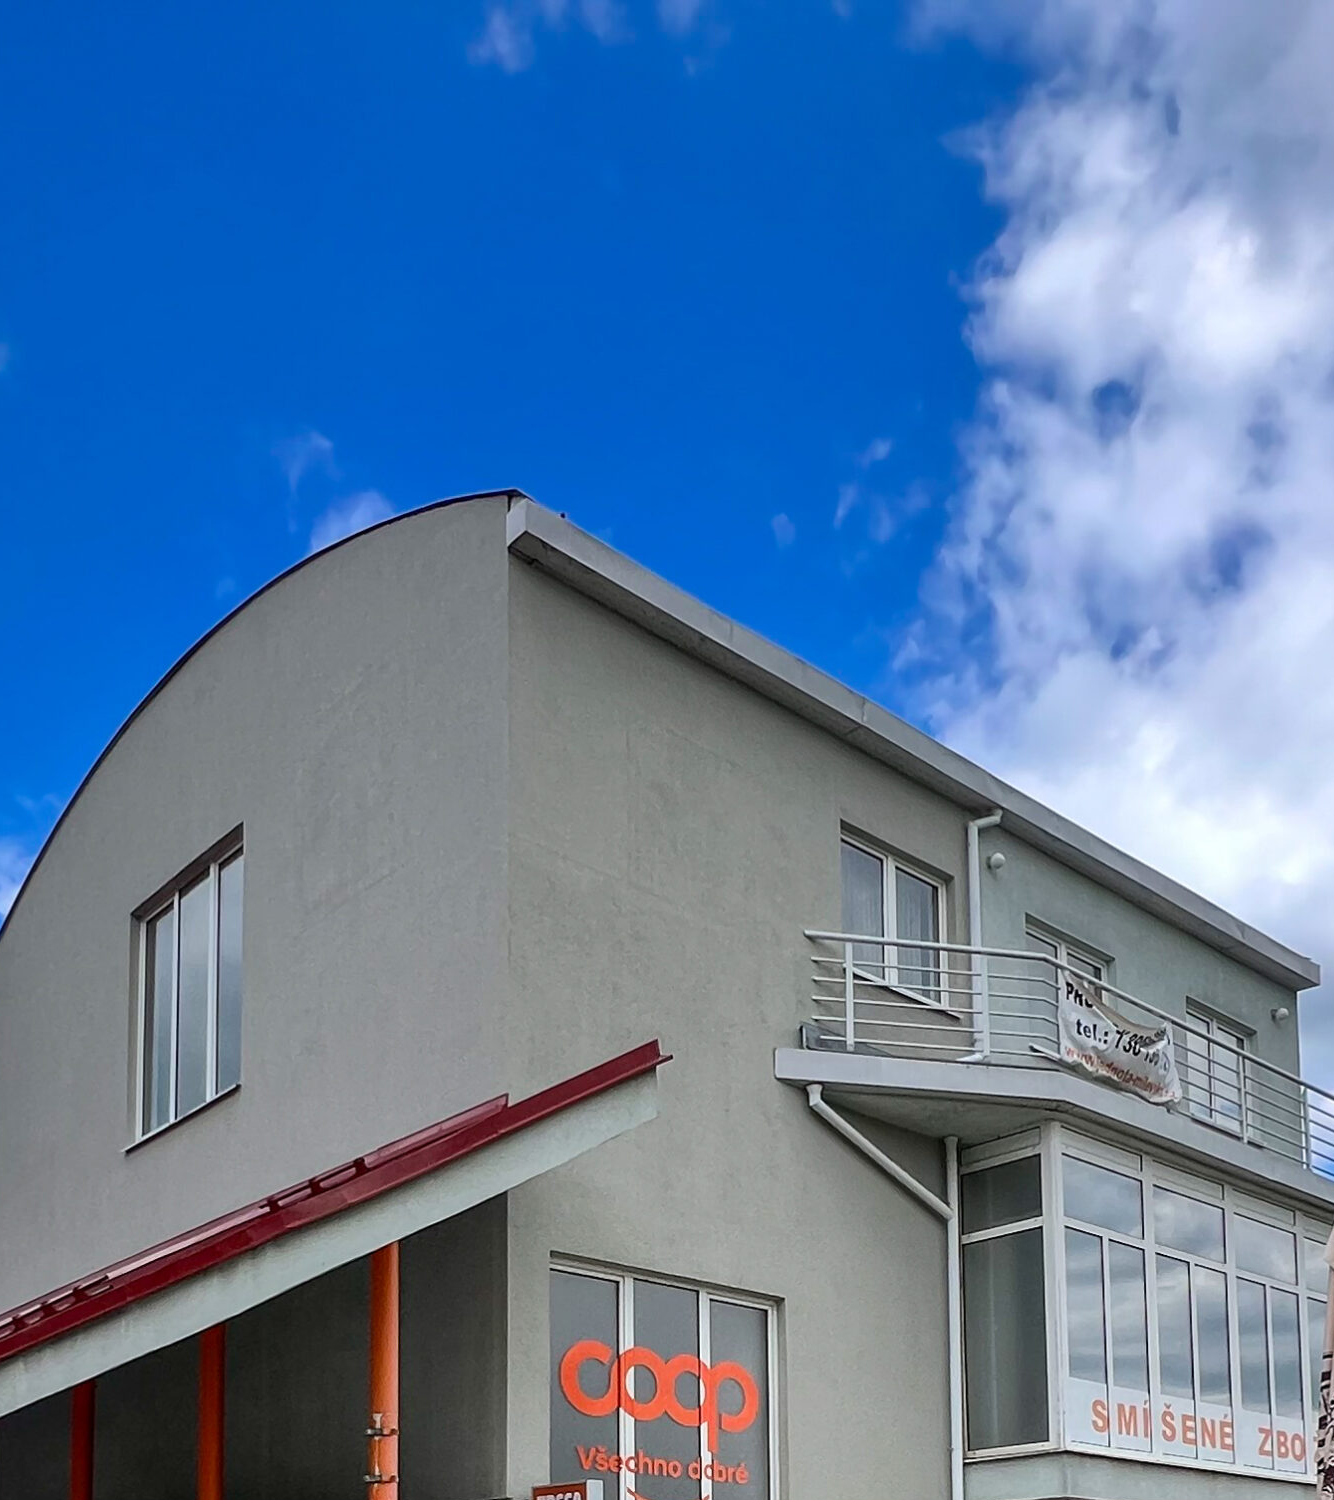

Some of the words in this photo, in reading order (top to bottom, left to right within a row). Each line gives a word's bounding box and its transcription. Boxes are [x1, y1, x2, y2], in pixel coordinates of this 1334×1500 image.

[1076, 1019, 1109, 1044] tel.:
[1257, 1426, 1318, 1464] ZBO
[576, 1446, 682, 1478] Všechno
[688, 1456, 749, 1484] dobré
